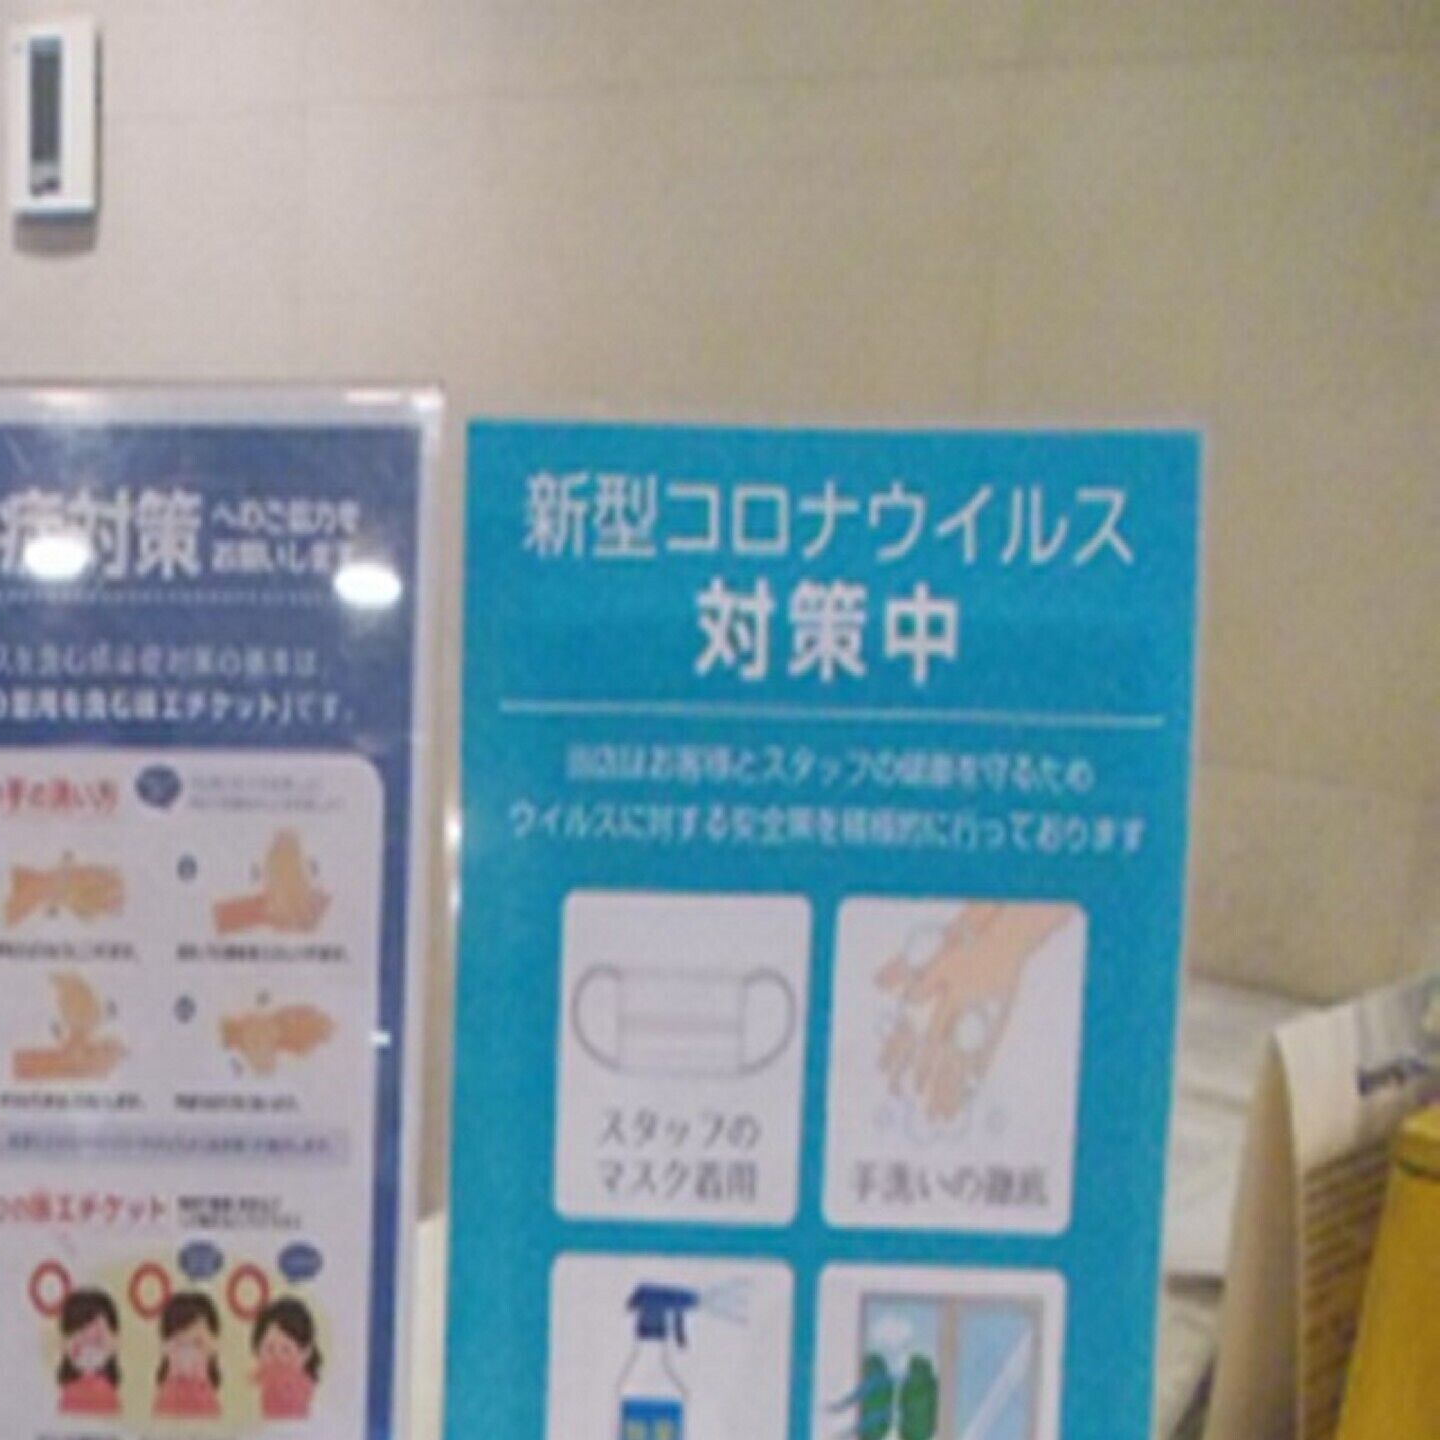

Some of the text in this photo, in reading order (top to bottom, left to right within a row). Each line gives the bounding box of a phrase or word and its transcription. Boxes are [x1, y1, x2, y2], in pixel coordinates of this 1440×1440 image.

[522, 470, 1135, 566] 新型コロナウイルス
[694, 578, 962, 686] 対策中
[598, 1108, 762, 1150] スタッフの
[598, 1159, 758, 1201] マスク着用
[856, 1160, 1050, 1206] 手洗いの徹底
